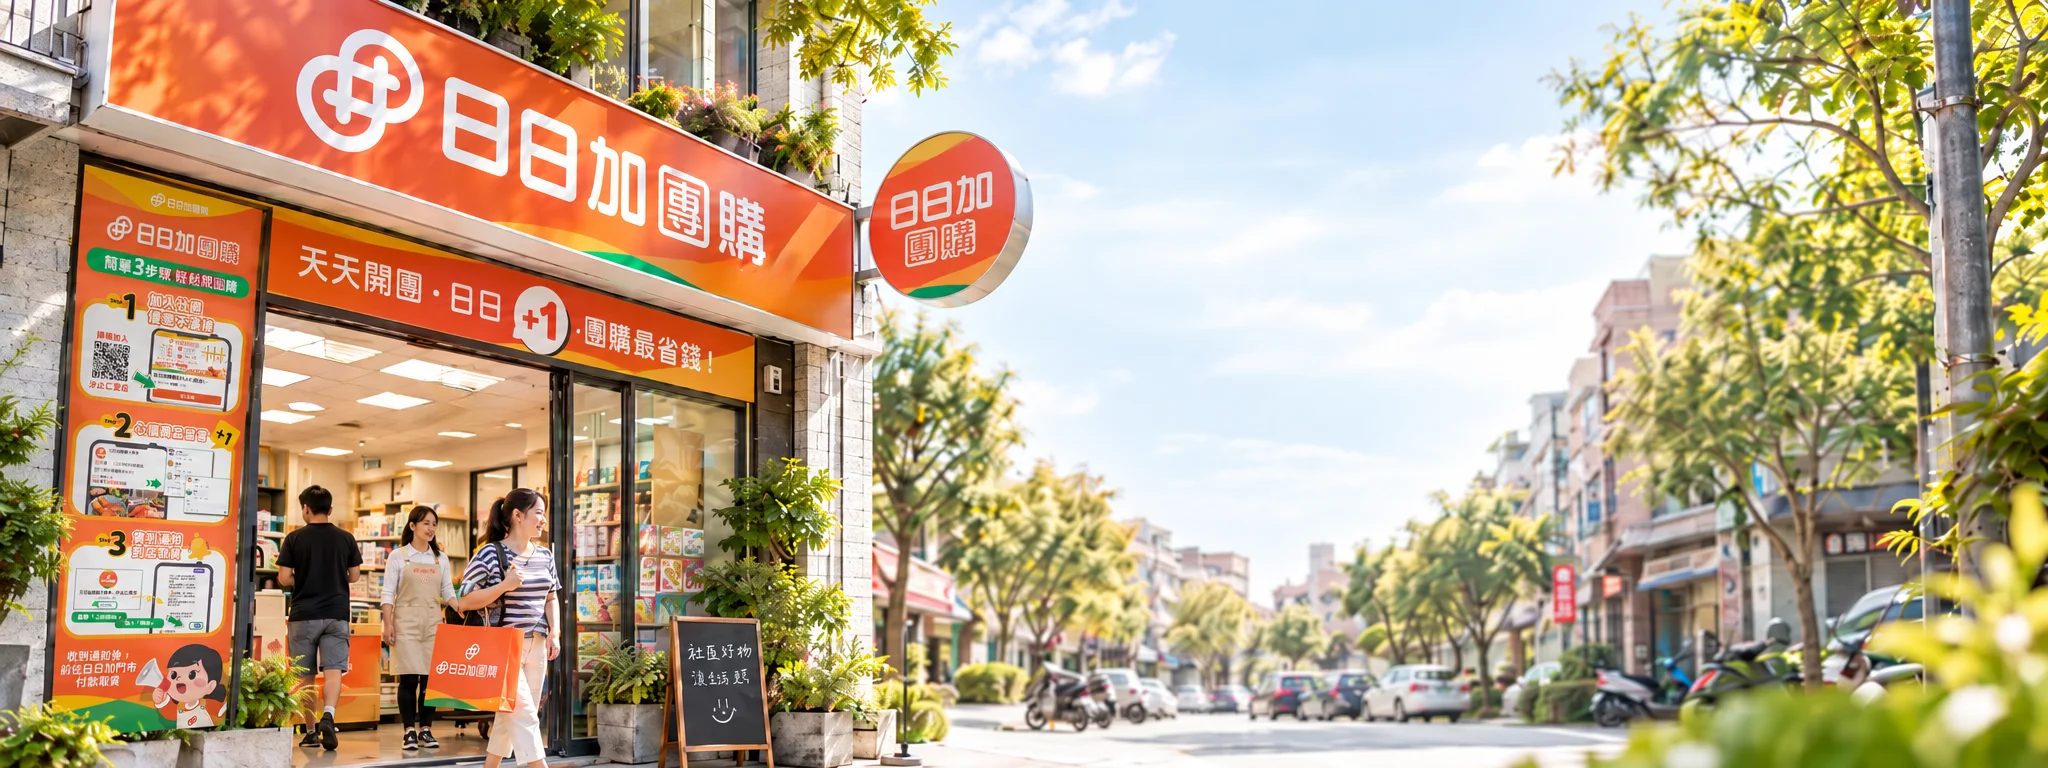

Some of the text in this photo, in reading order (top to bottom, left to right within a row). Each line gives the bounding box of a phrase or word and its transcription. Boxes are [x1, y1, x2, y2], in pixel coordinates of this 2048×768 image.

[442, 76, 767, 267] 日日加團購
[890, 171, 993, 231] 日日加
[904, 218, 976, 268] 團購
[123, 293, 136, 320] 1
[522, 300, 559, 343] +1
[114, 413, 132, 438] 2
[216, 428, 233, 446] +1
[108, 530, 127, 556] 3
